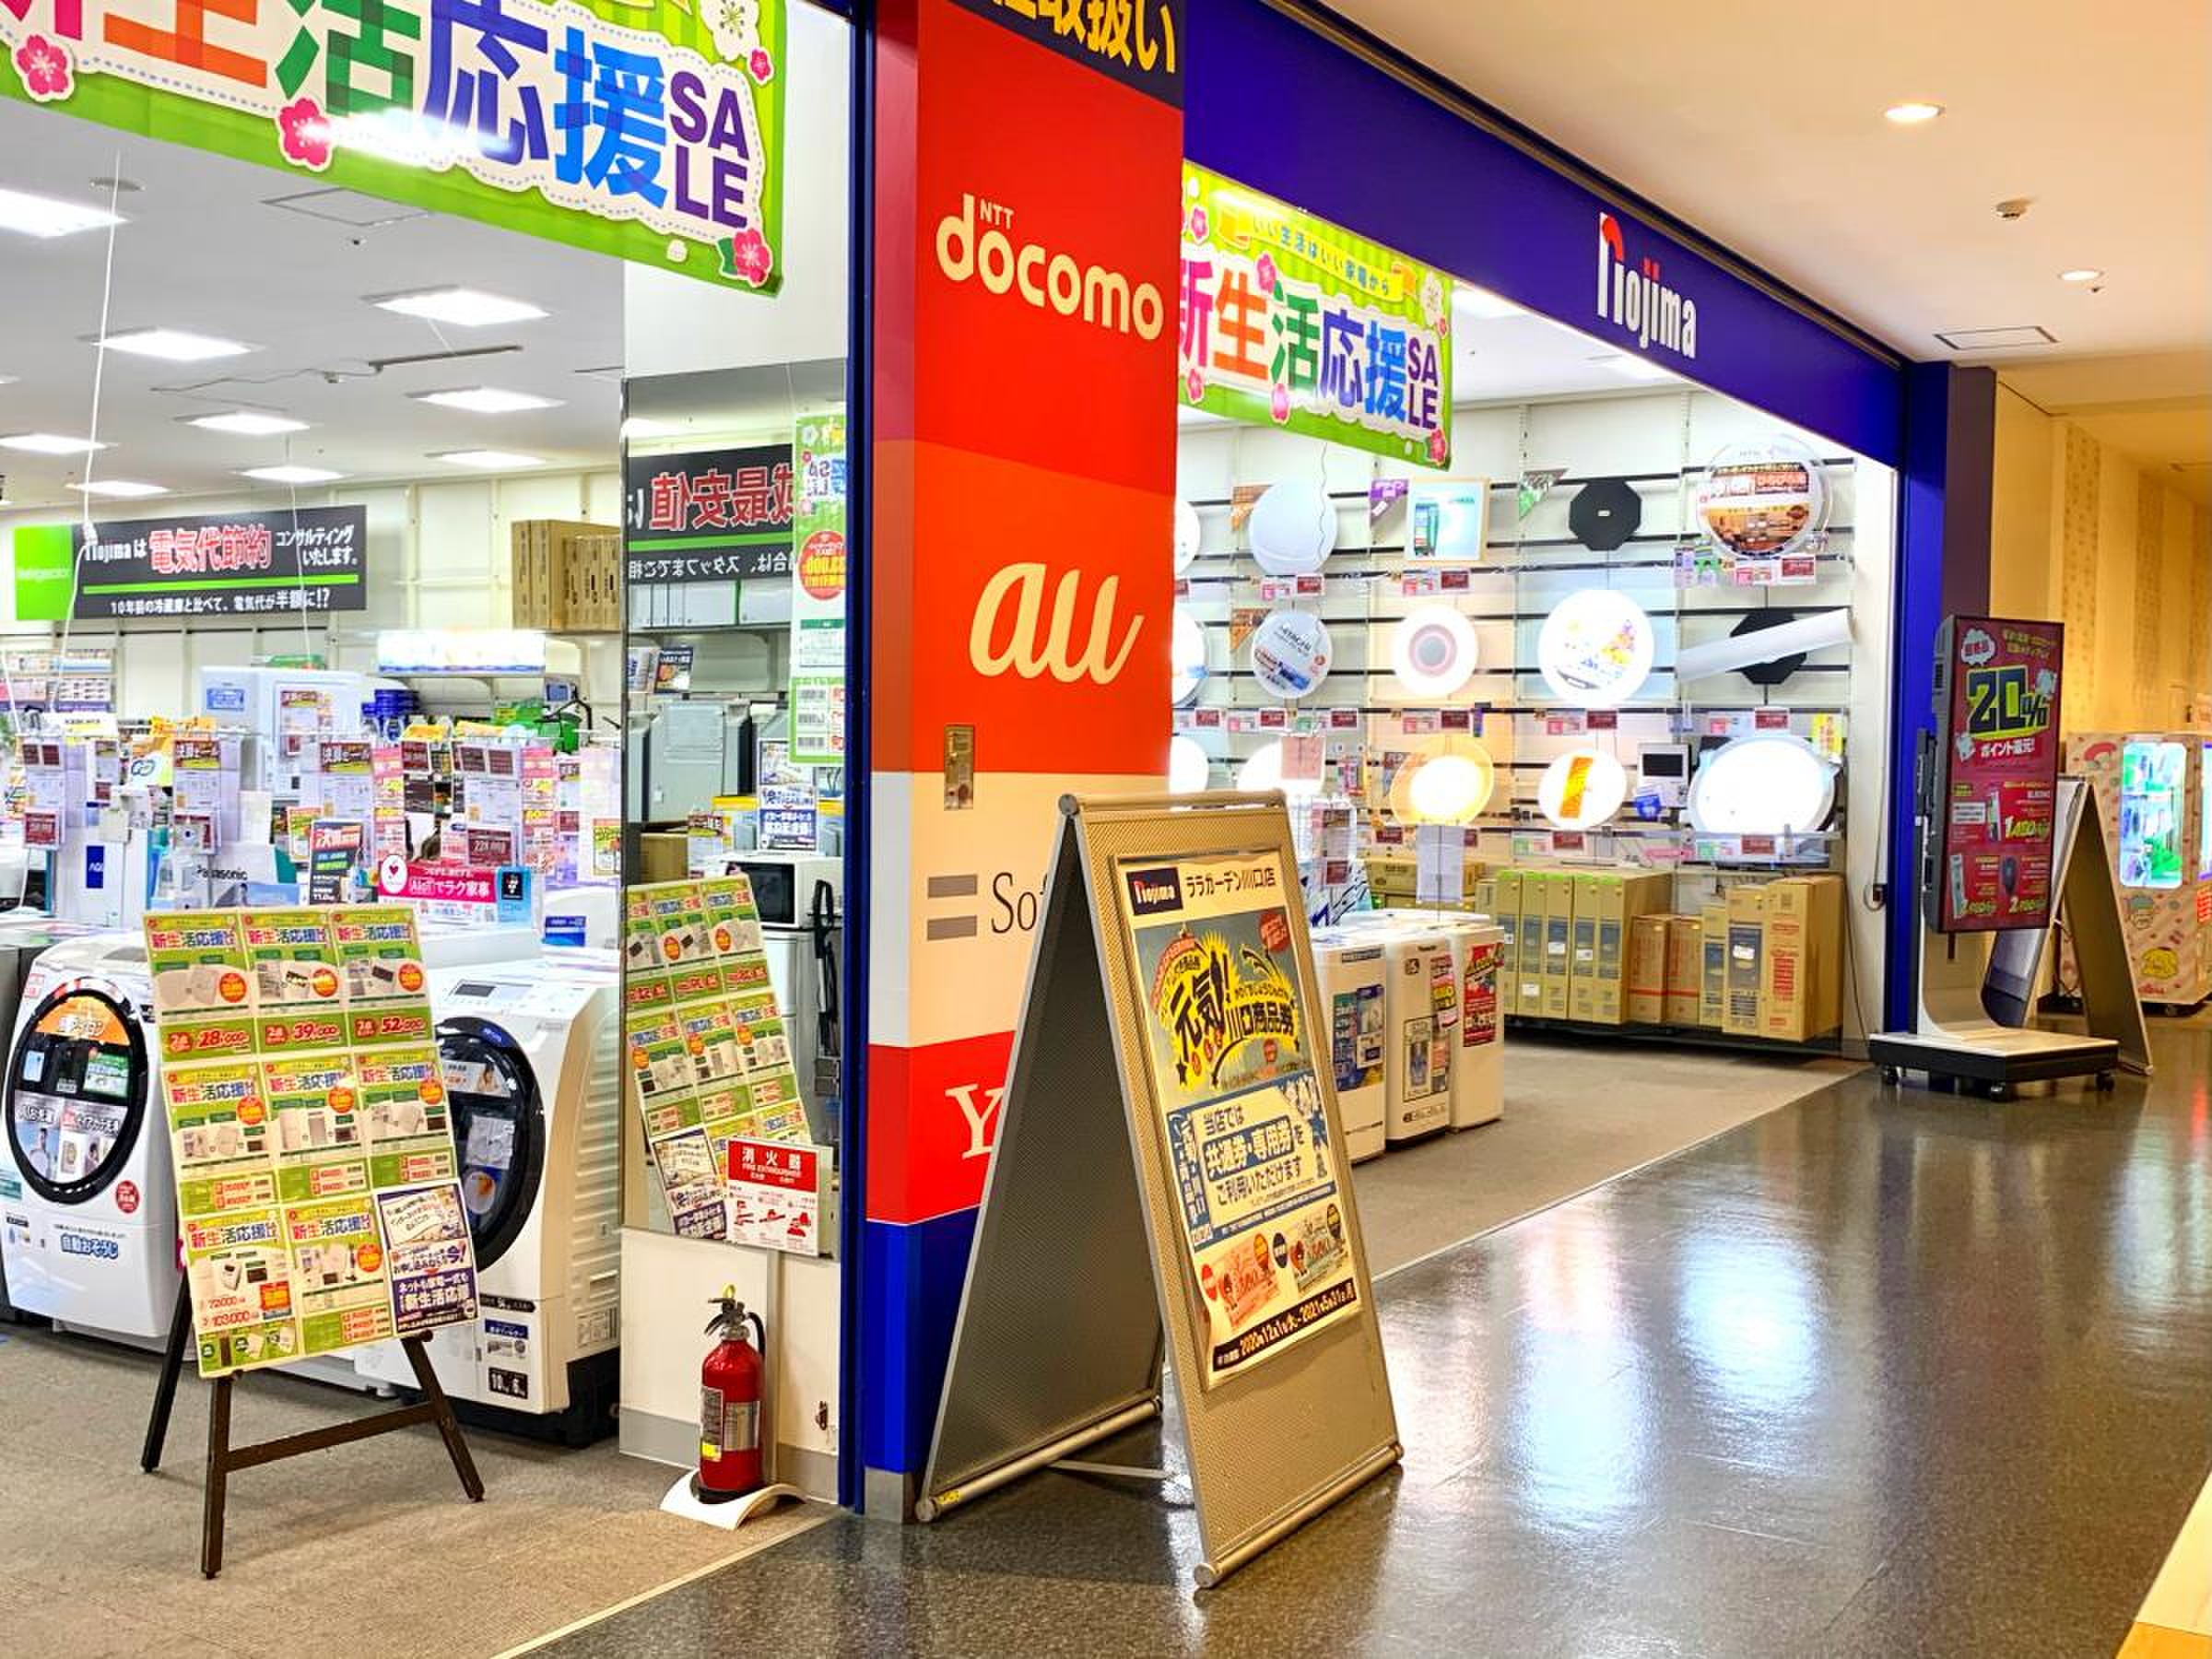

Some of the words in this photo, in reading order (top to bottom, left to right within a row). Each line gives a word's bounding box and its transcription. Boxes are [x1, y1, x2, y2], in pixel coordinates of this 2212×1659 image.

[980, 198, 1015, 229] NTT
[935, 193, 1164, 340] docomo
[970, 562, 1144, 684] au
[1968, 667, 2048, 734] 20%
